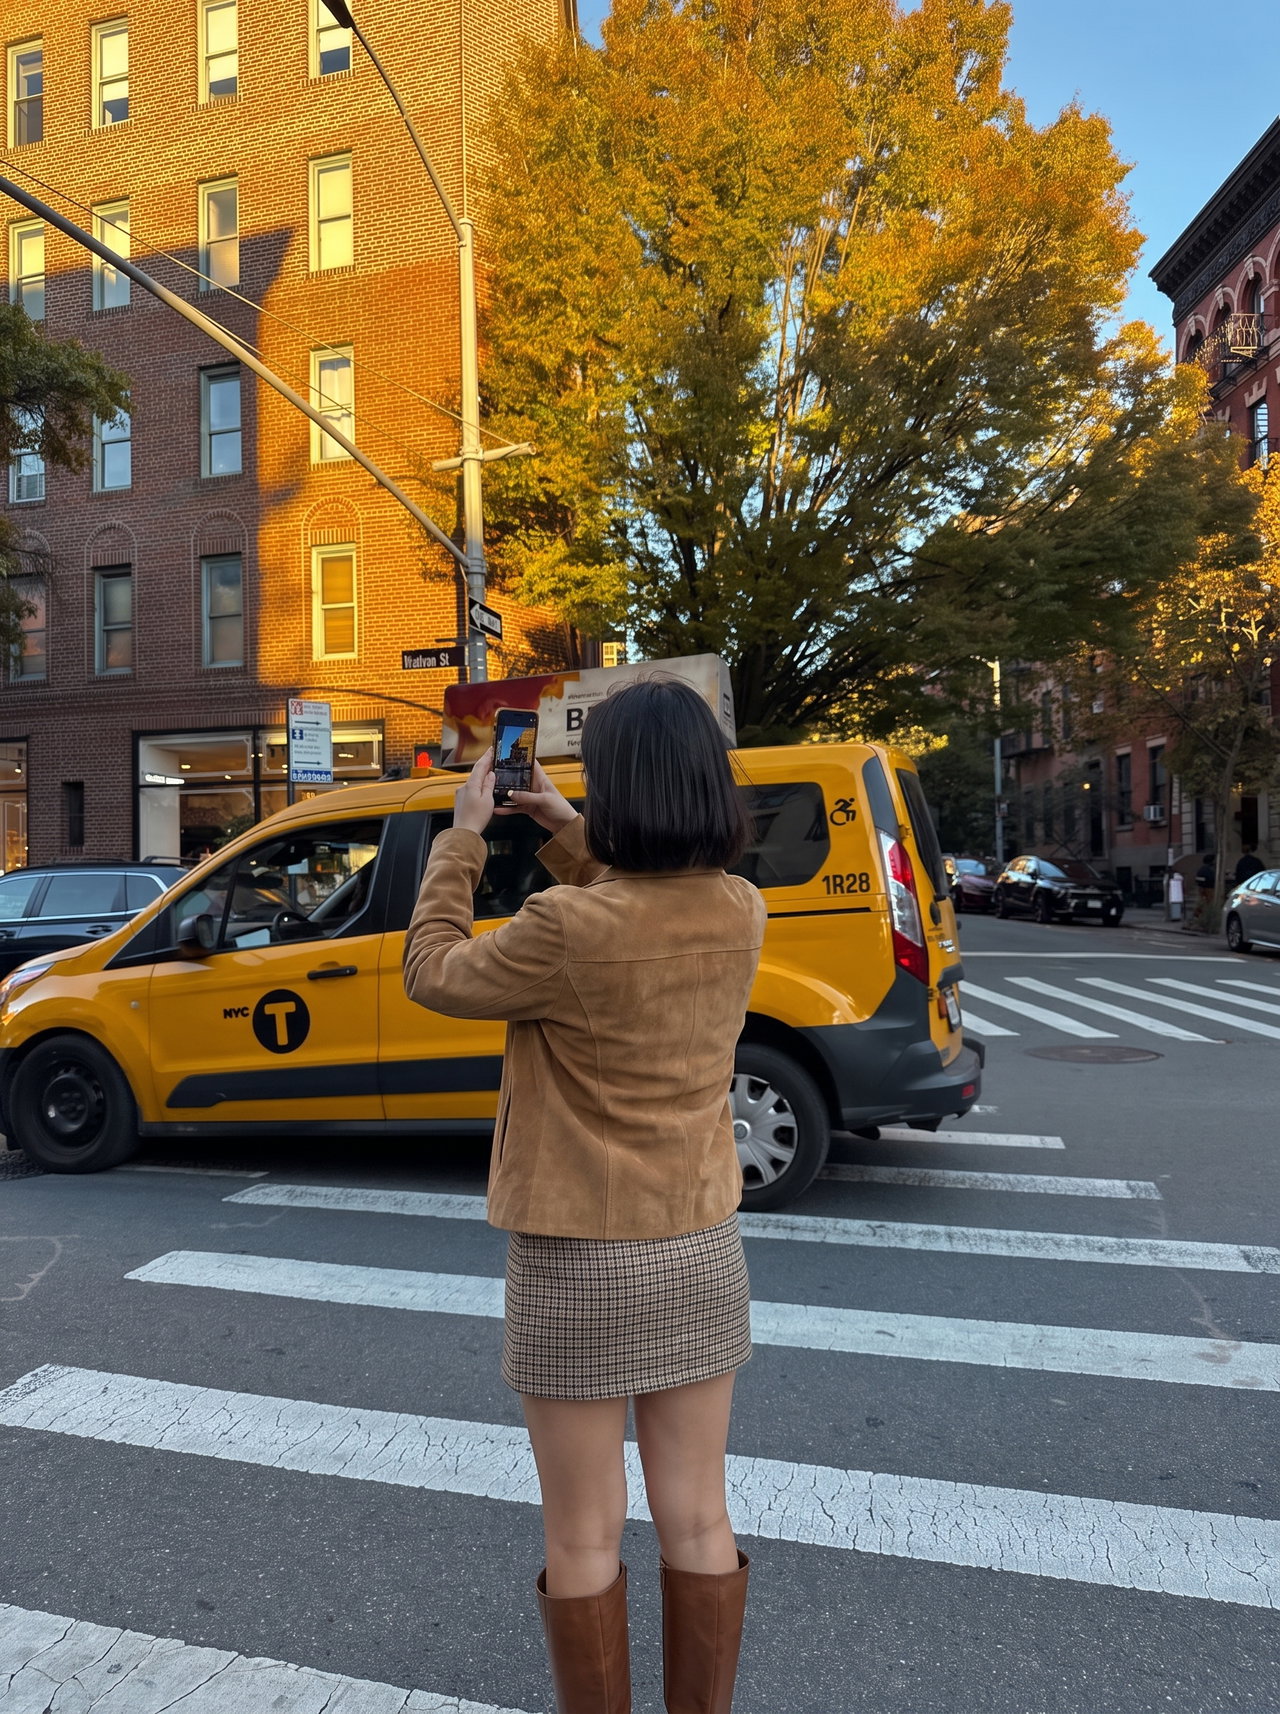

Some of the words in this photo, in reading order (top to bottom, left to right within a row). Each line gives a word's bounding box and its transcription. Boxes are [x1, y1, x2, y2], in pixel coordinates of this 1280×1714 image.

[439, 652, 450, 667] St
[566, 706, 593, 732] B
[822, 872, 871, 895] 1R28
[223, 1006, 250, 1019] NYC
[264, 1001, 297, 1046] T
